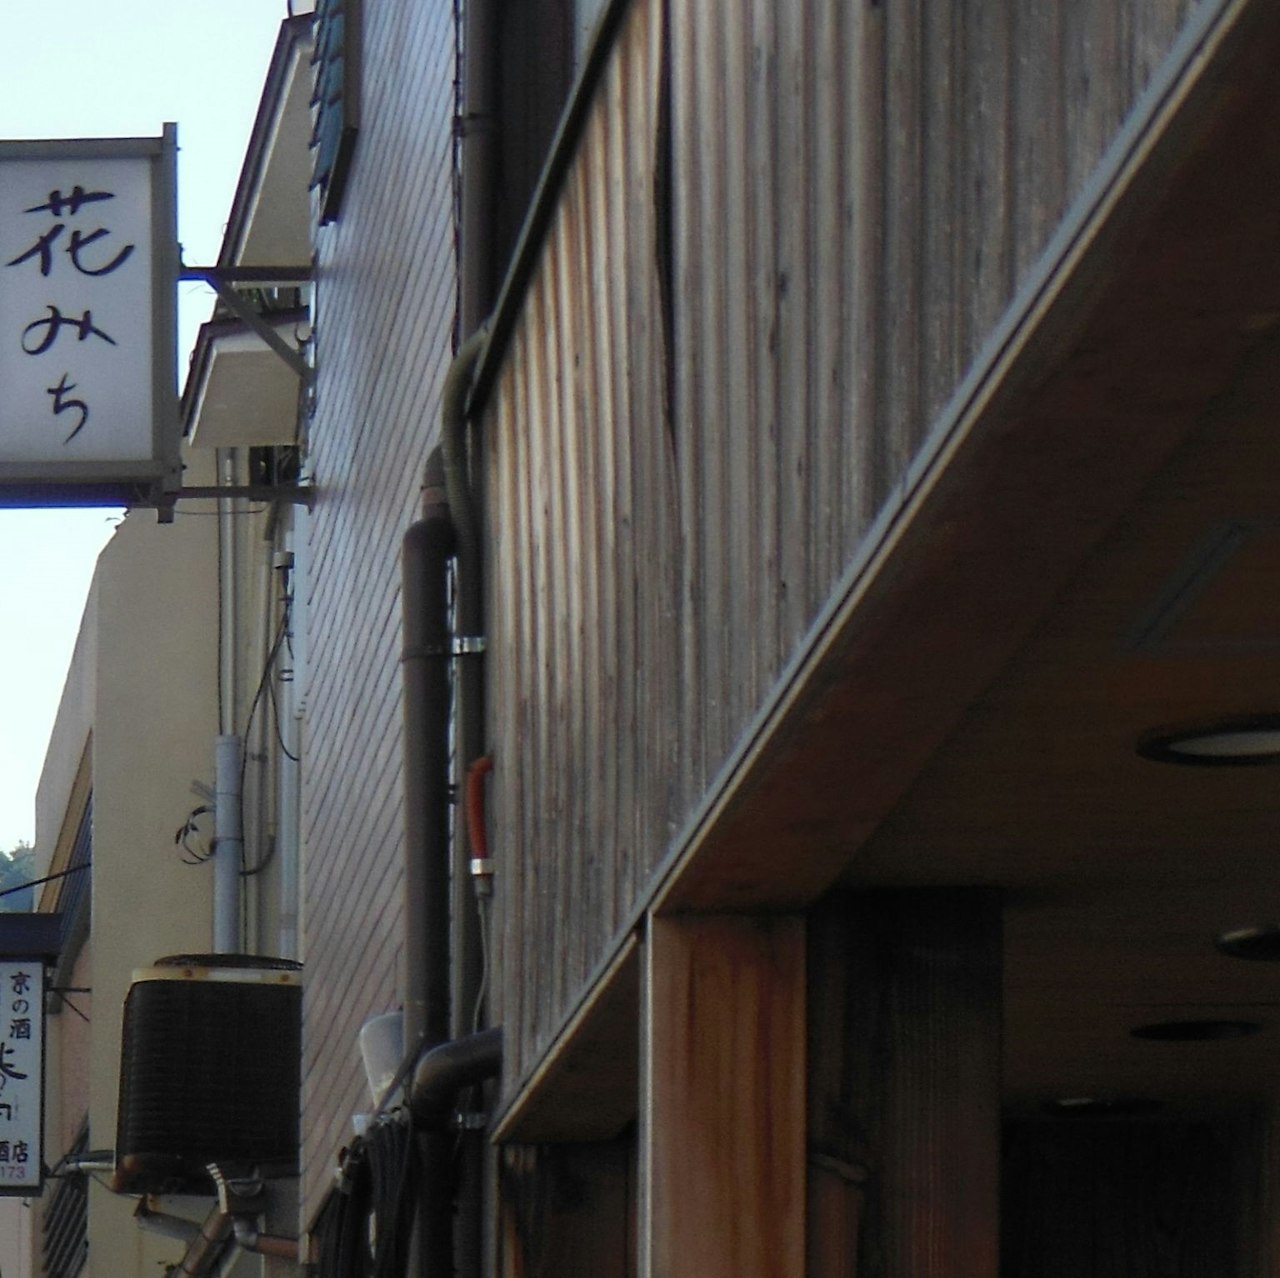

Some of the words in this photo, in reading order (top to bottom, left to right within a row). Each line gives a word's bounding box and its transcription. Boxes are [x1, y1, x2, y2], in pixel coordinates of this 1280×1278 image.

[5, 185, 135, 446] 花みち
[9, 971, 31, 1039] 京の酒
